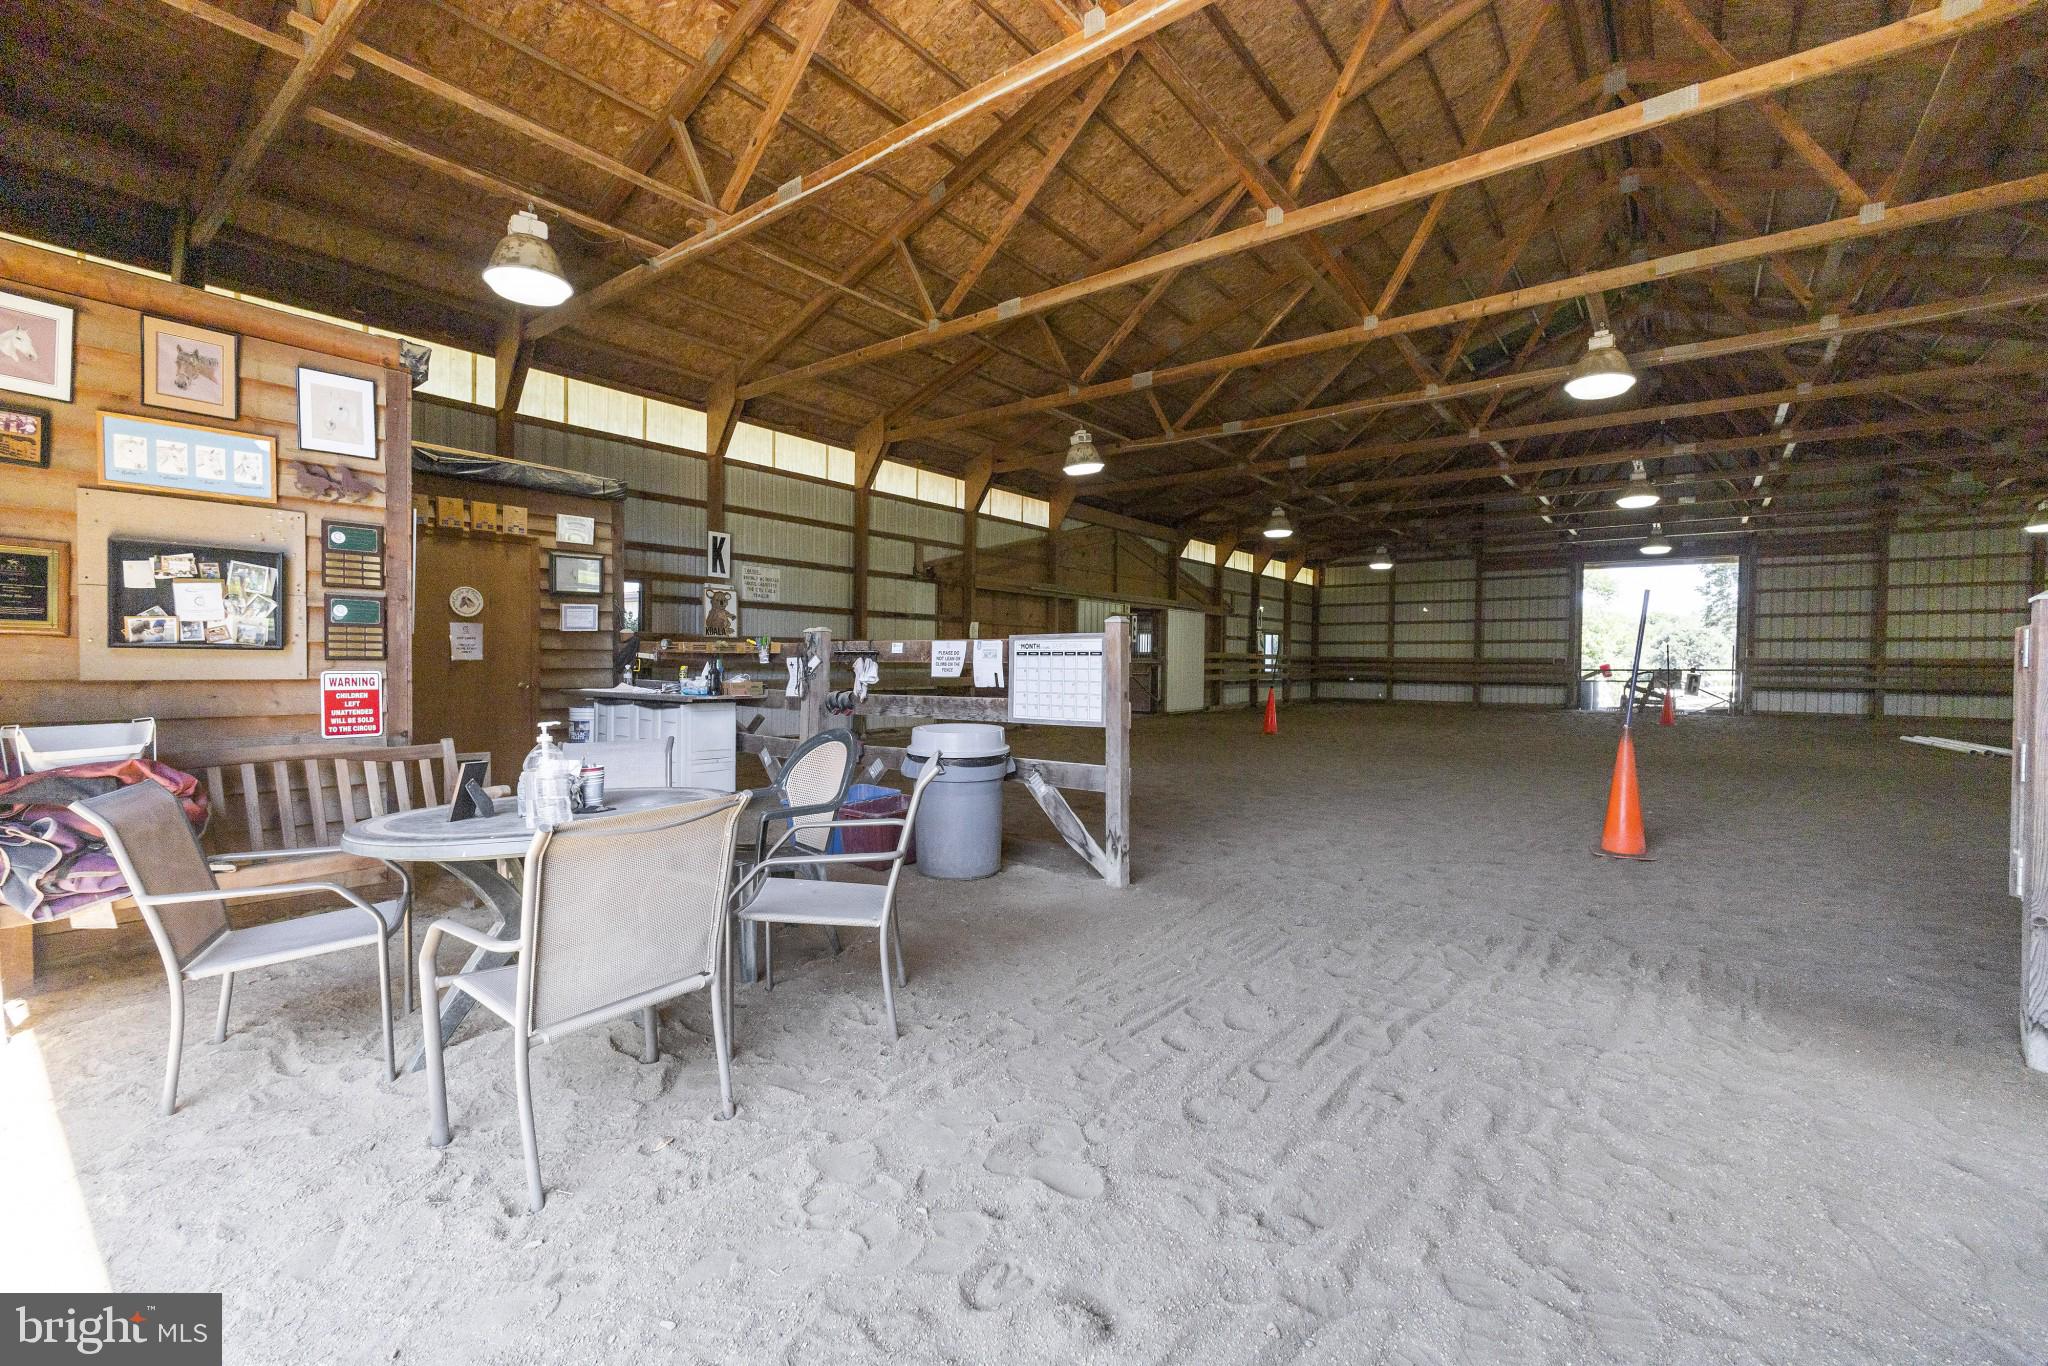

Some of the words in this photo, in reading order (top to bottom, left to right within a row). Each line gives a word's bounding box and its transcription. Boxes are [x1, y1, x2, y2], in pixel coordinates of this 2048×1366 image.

[712, 536, 726, 574] K
[706, 627, 726, 636] KOALA
[328, 677, 375, 687] WARNING
